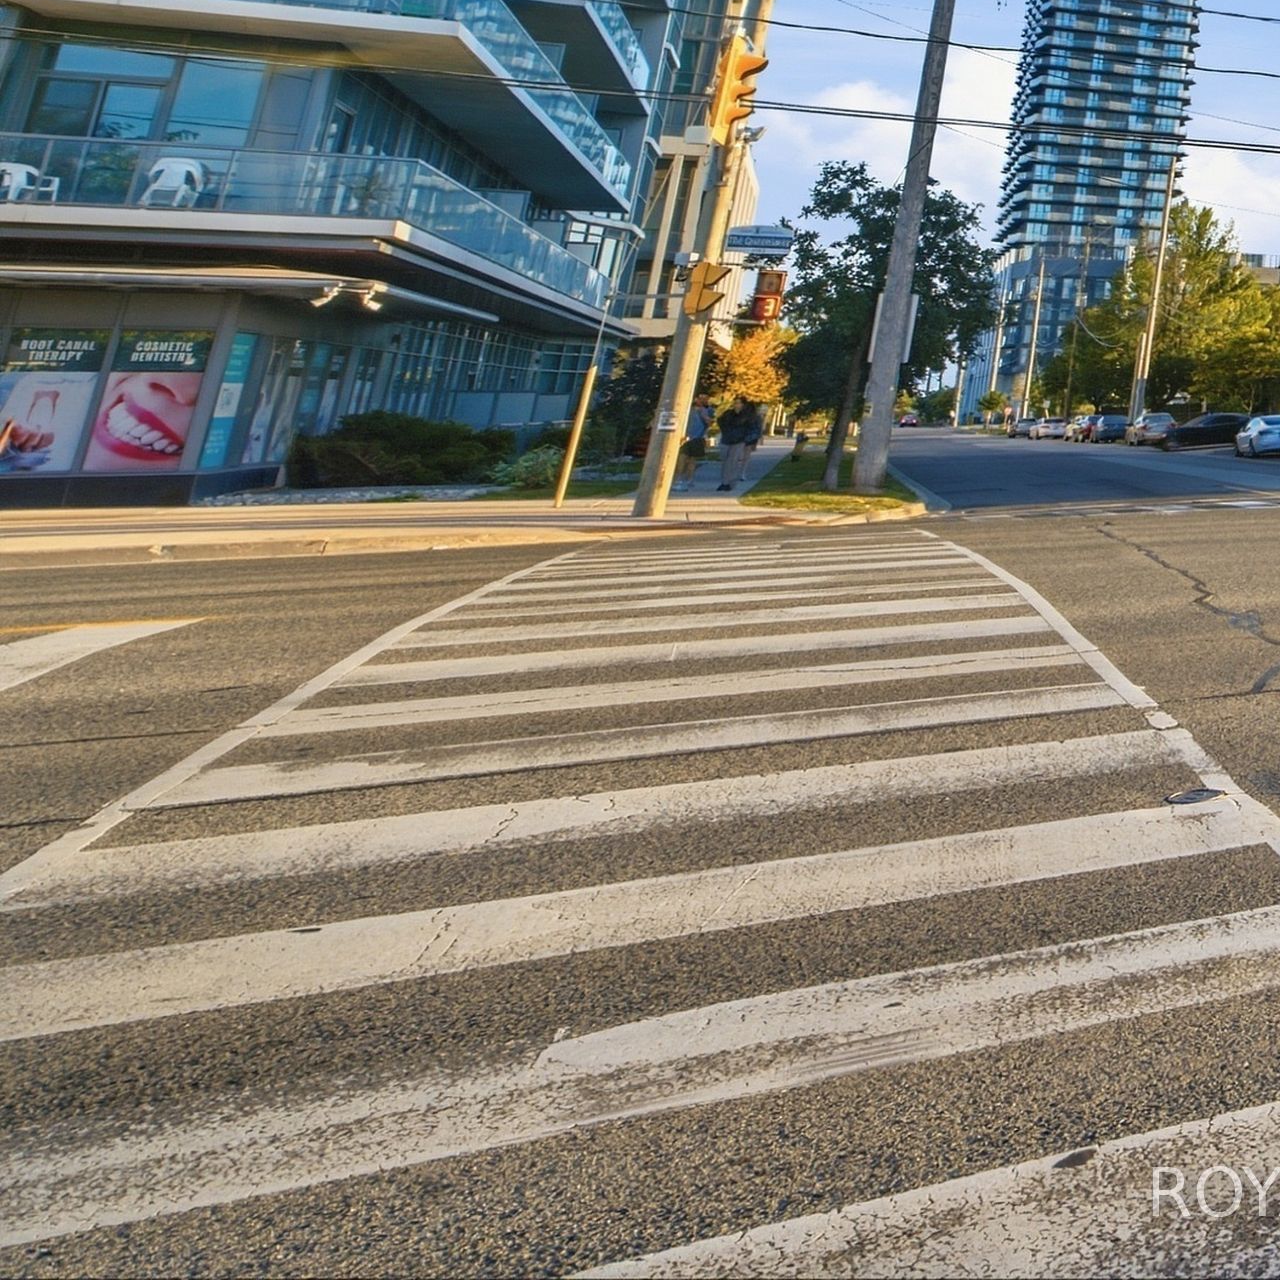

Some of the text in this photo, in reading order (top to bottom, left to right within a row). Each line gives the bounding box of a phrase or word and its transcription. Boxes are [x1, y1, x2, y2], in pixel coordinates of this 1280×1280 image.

[135, 341, 194, 352] COSMETIC
[28, 351, 84, 361] THERAPY
[130, 352, 194, 363] DENTISTRY
